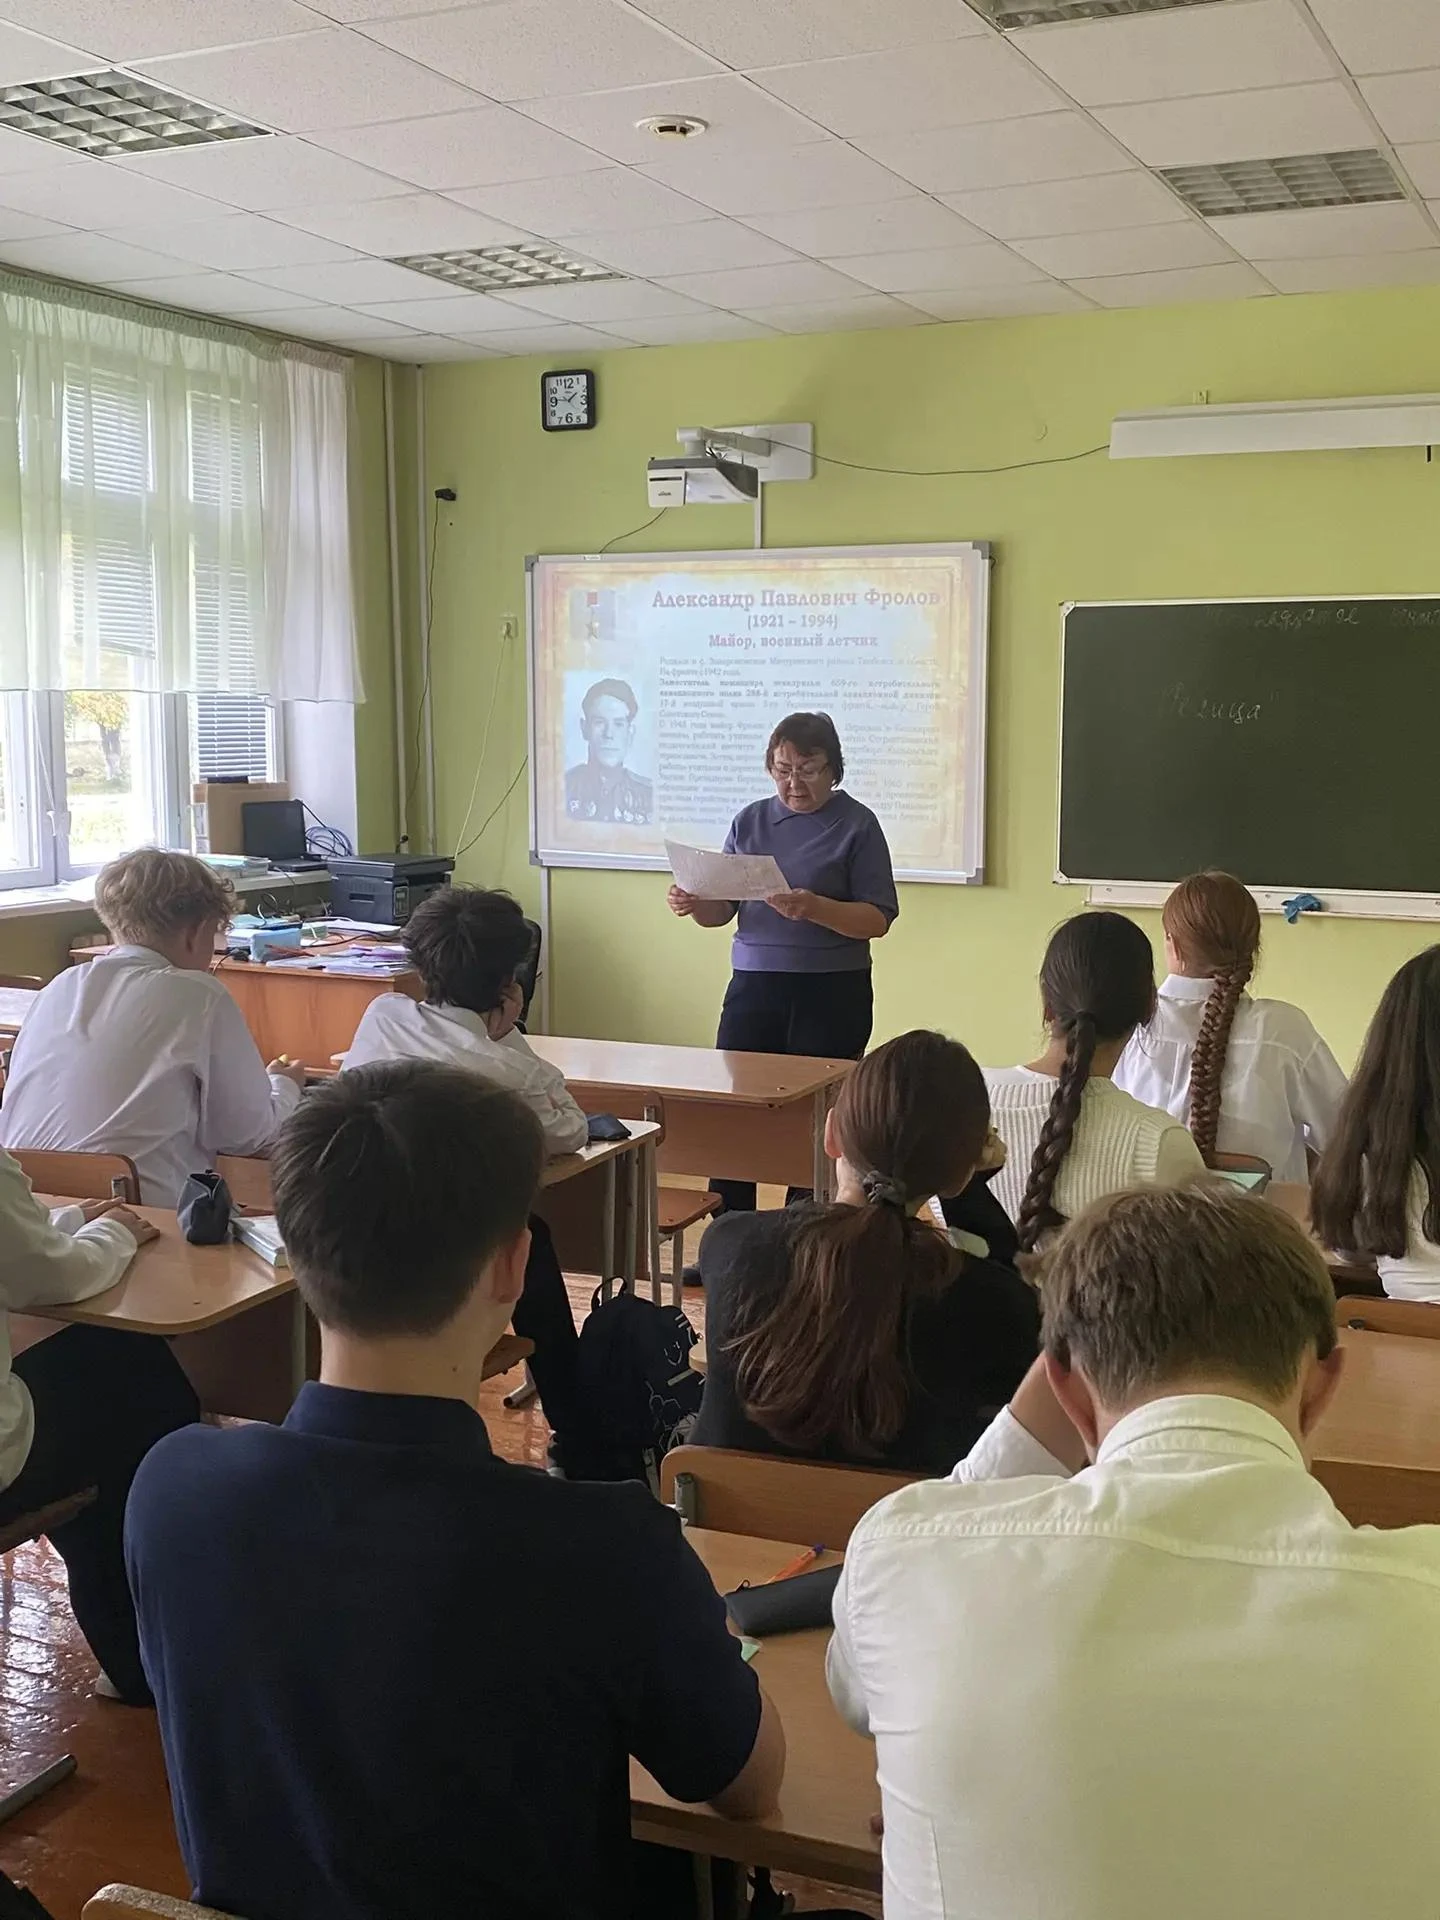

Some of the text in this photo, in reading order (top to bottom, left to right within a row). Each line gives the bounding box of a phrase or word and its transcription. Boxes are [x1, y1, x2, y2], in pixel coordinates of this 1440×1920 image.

[564, 377, 574, 389] 12
[576, 377, 580, 385] 1
[550, 387, 558, 395] 10
[550, 396, 558, 408] 9
[580, 394, 588, 406] 3
[565, 412, 574, 424] 6
[652, 589, 941, 612] Александр Павлович Фролов
[747, 615, 784, 630] (1921
[800, 615, 838, 630] 1994)
[709, 634, 878, 649] Майор, военный летчик
